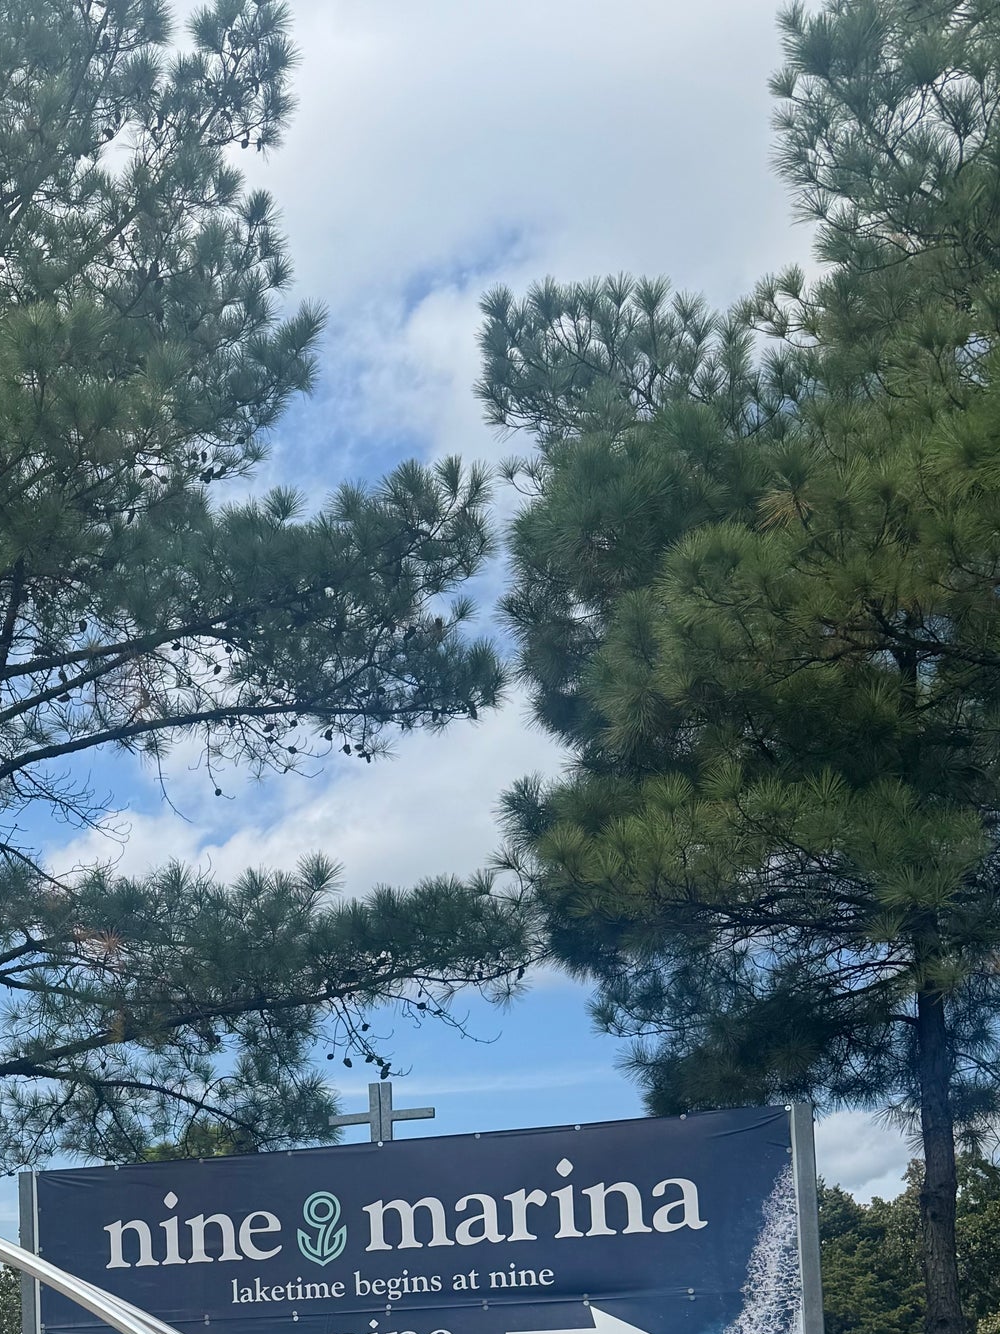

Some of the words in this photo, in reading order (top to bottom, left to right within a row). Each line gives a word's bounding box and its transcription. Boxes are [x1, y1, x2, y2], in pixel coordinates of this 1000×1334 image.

[103, 1191, 282, 1269] nine
[362, 1157, 708, 1252] marina
[231, 1276, 345, 1303] laketime
[353, 1269, 442, 1300] begins
[452, 1269, 480, 1291] at
[488, 1262, 555, 1288] nine
